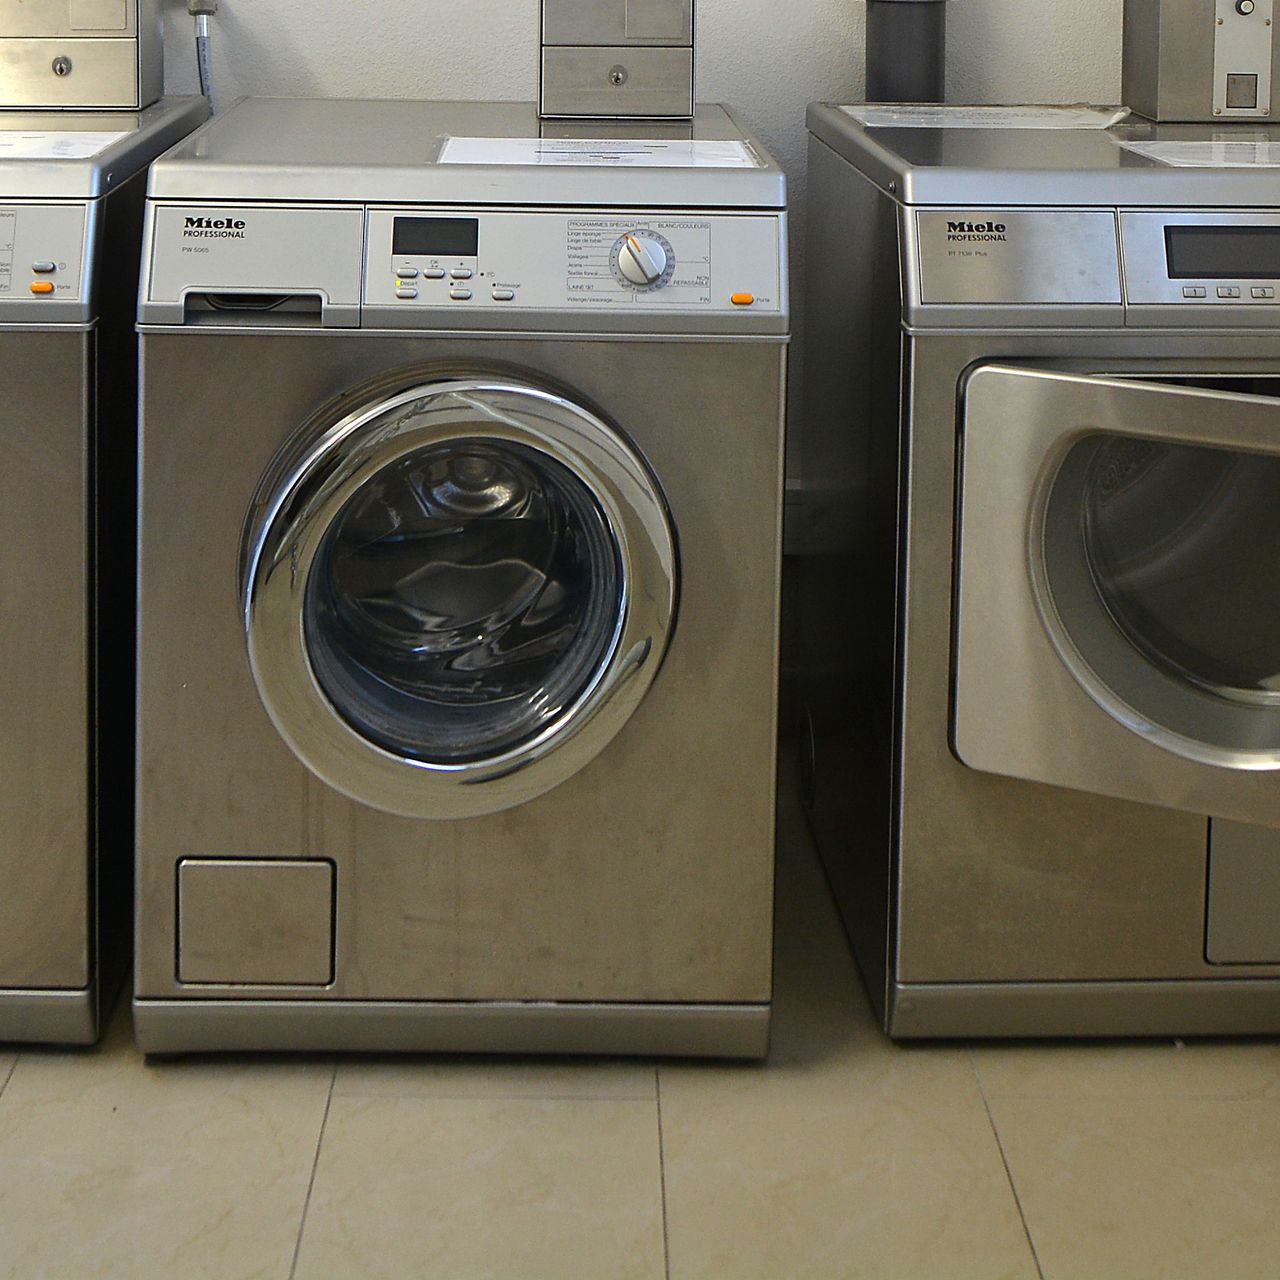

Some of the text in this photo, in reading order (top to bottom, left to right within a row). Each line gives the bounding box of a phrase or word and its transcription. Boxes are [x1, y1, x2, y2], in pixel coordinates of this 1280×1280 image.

[184, 217, 246, 229] Miele
[947, 221, 1006, 233] Miele
[183, 230, 245, 238] PROFESSIONAL
